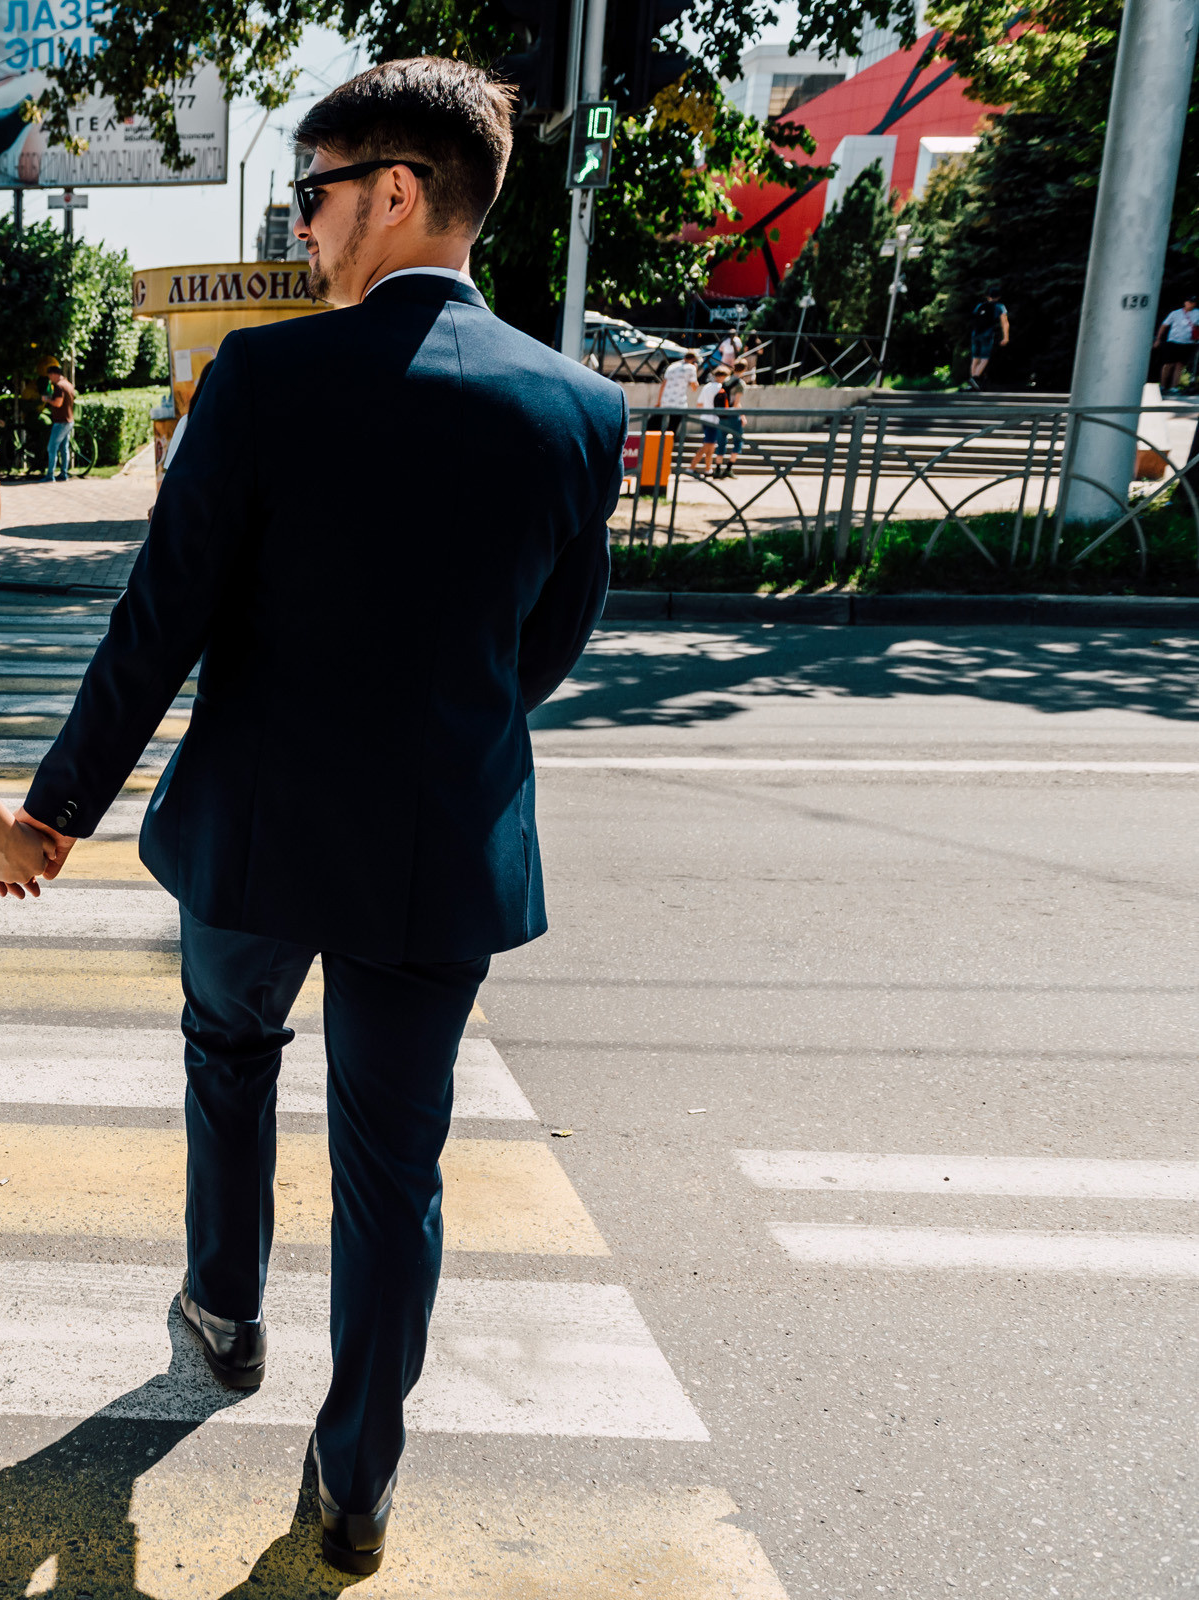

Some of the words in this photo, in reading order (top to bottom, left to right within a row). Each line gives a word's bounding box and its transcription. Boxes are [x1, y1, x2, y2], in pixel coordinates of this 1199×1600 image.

[3, 0, 112, 32] ЛАЗЕ
[587, 106, 613, 139] 10
[133, 279, 147, 307] С
[168, 270, 322, 305] ЛИМОНА
